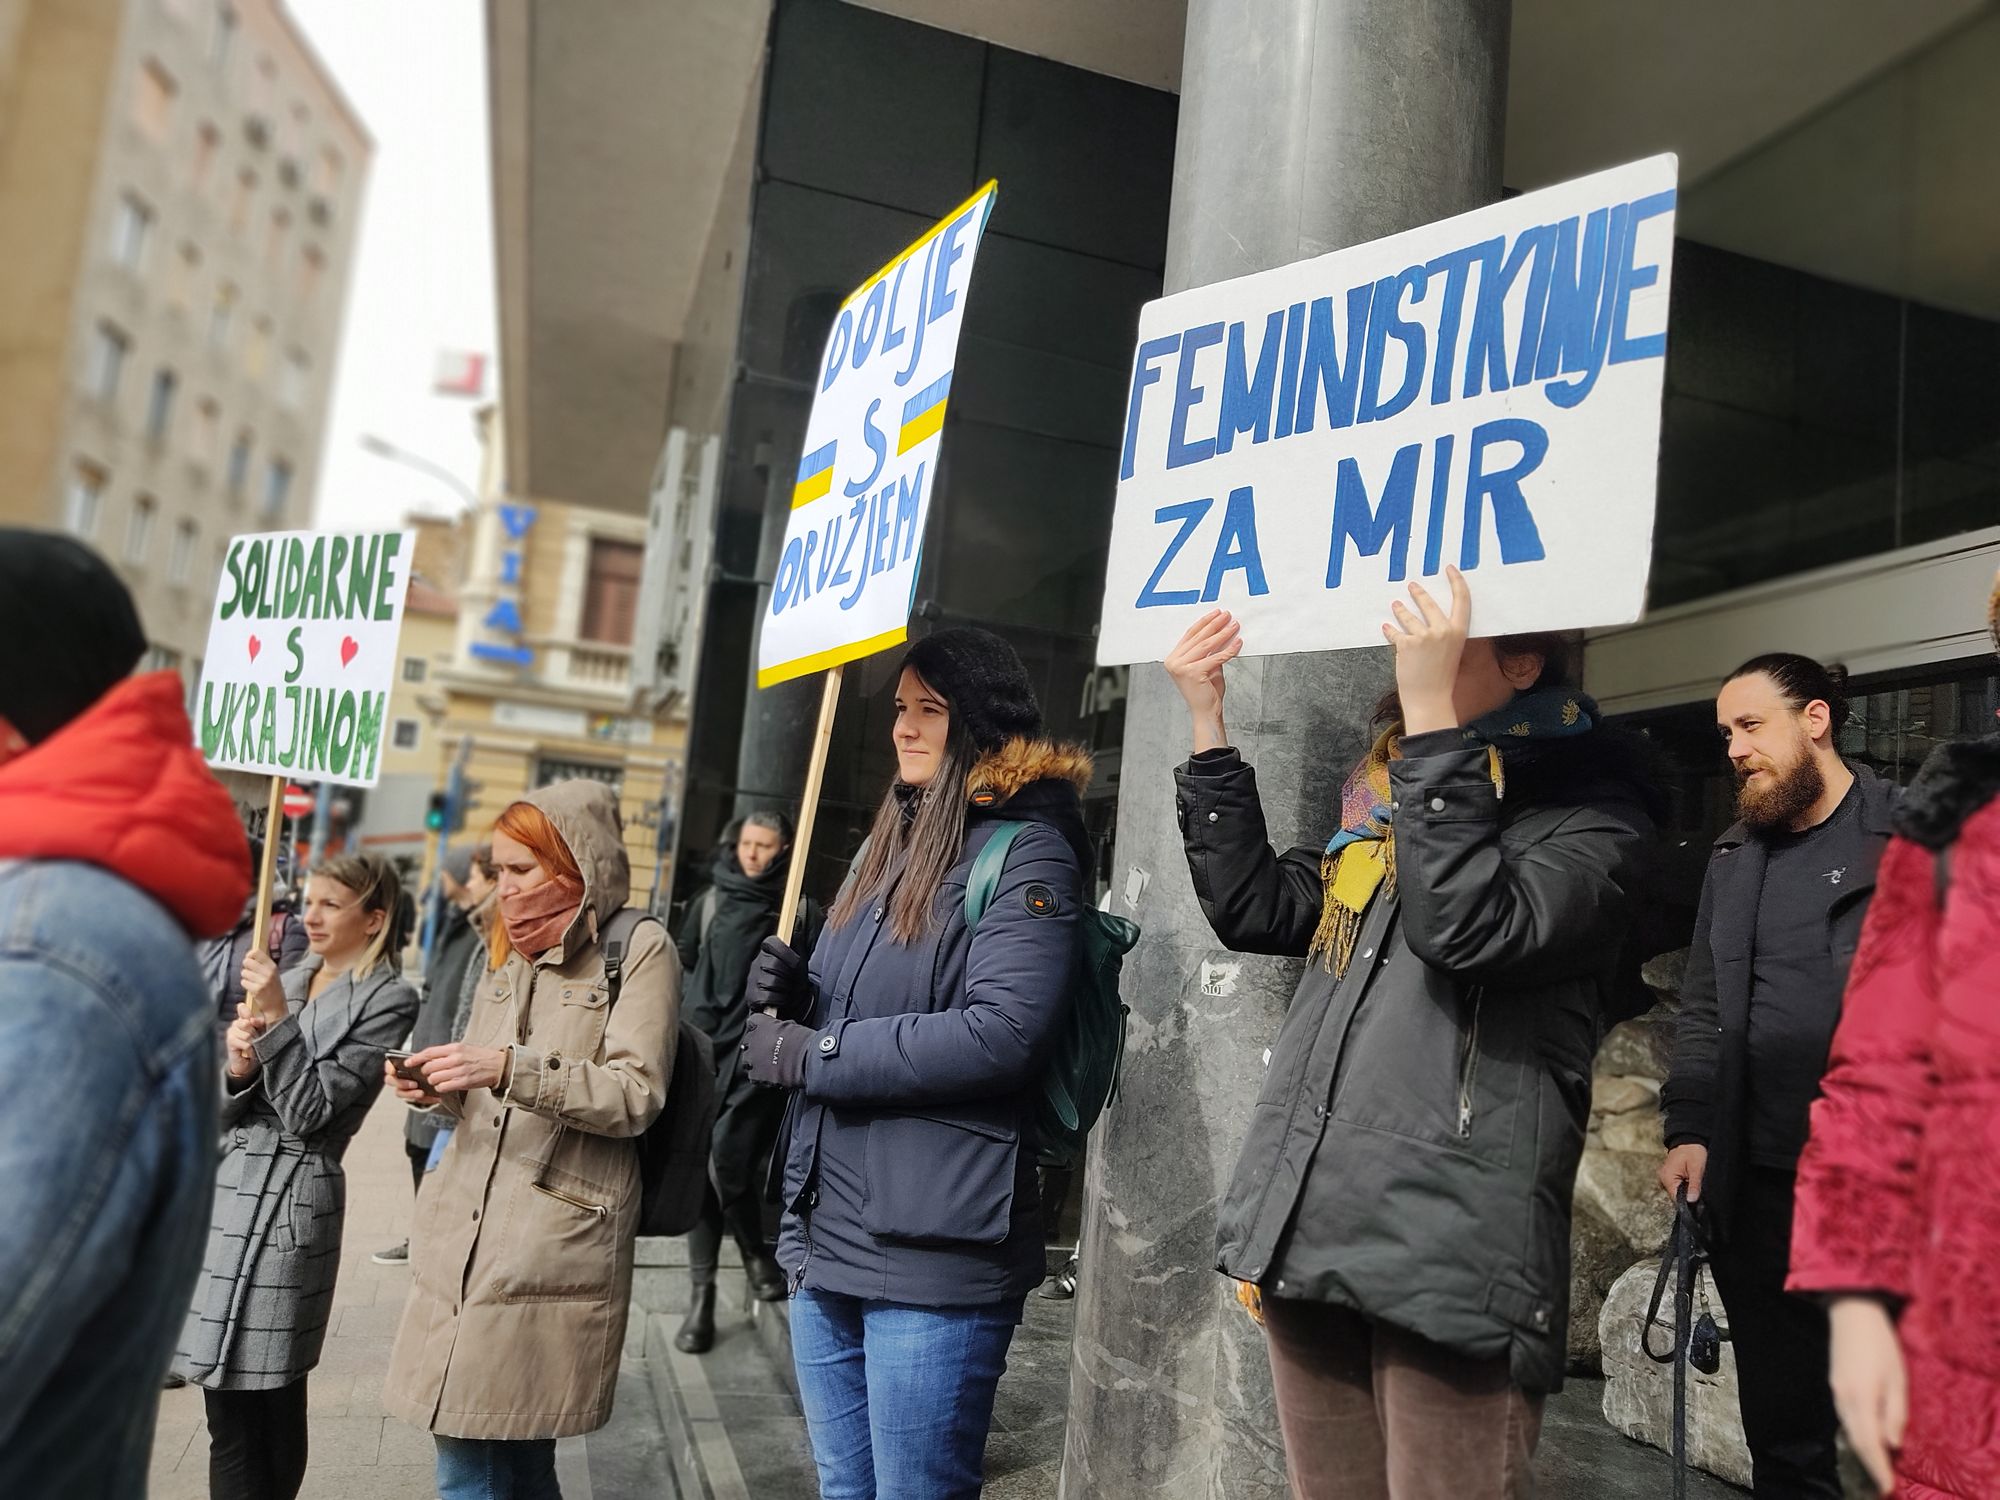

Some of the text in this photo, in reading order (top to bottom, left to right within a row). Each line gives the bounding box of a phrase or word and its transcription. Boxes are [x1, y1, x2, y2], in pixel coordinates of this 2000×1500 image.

[822, 206, 977, 391] DOLJE
[1121, 188, 1676, 481] FEMINISTKINJE
[843, 397, 887, 499] S
[220, 533, 403, 621] SOLIDARNE
[772, 461, 926, 616] ORUŽJEM
[1135, 418, 1549, 609] ZA MIR
[284, 626, 304, 683] S
[201, 680, 386, 780] UKRAJINOM
